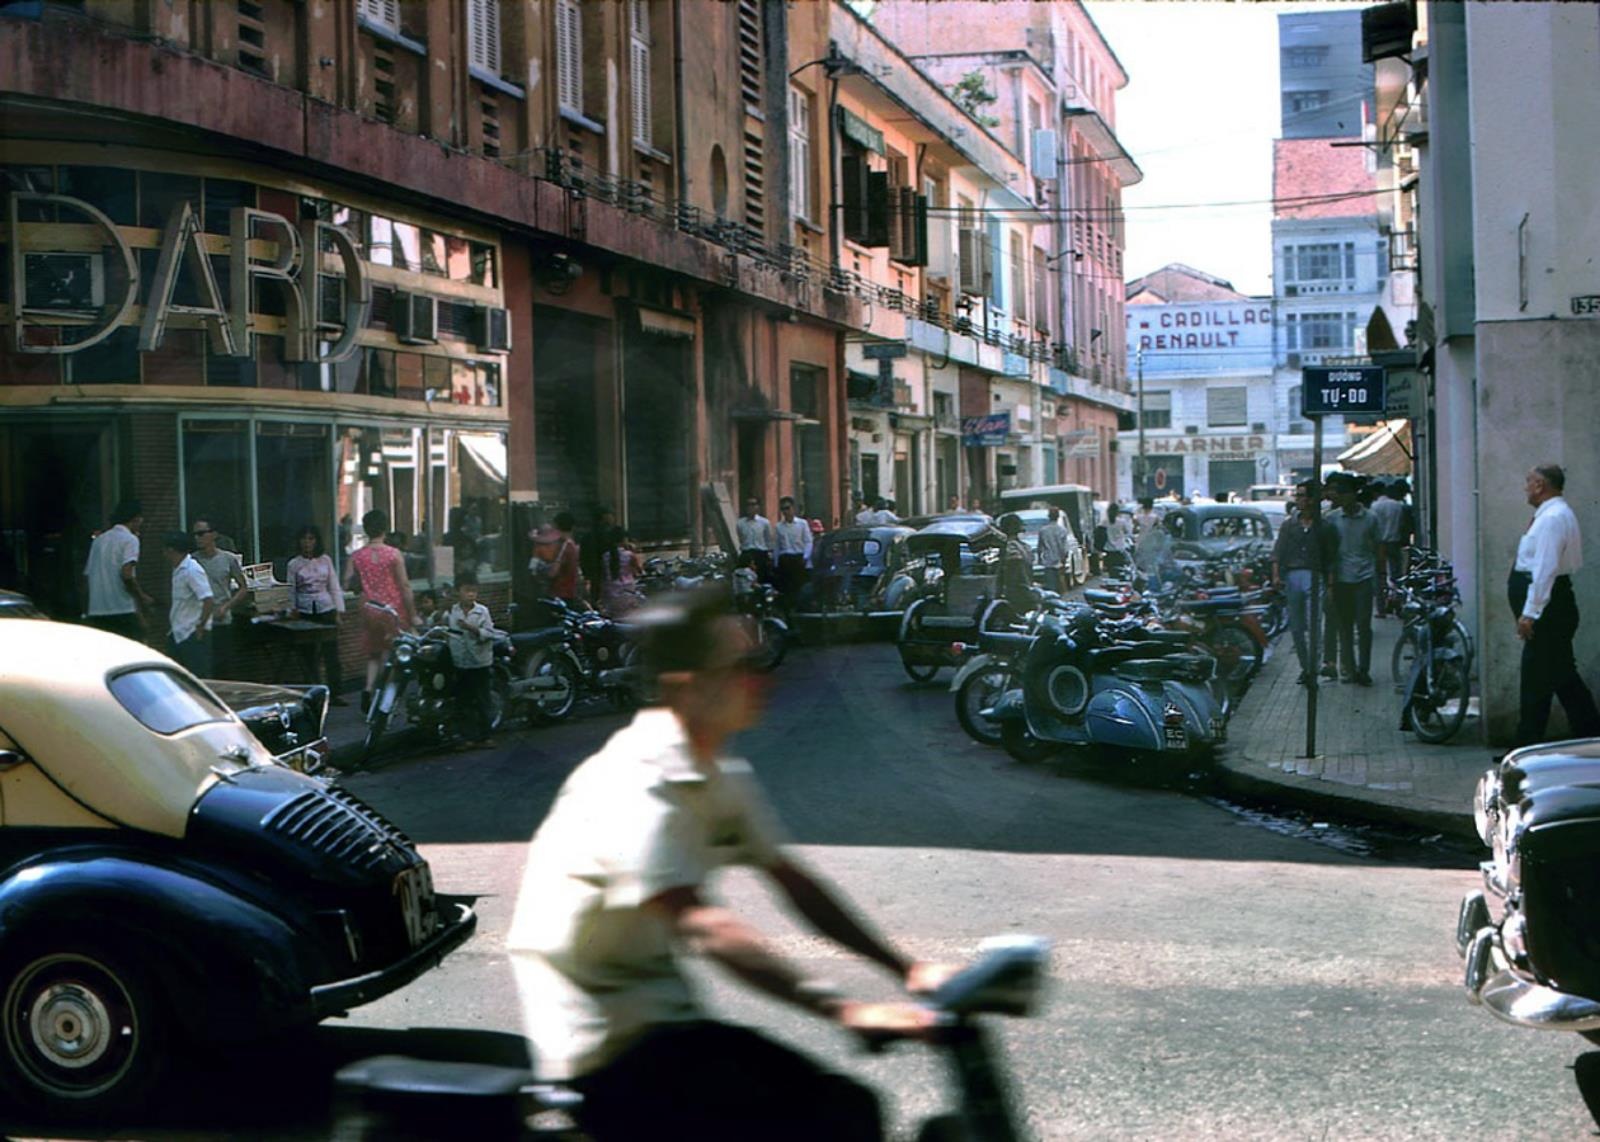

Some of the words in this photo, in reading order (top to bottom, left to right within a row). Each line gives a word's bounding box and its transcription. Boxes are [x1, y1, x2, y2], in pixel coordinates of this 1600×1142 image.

[11, 191, 371, 363] DARD
[1160, 309, 1272, 328] CADILLAC
[1140, 331, 1239, 350] RENAULT
